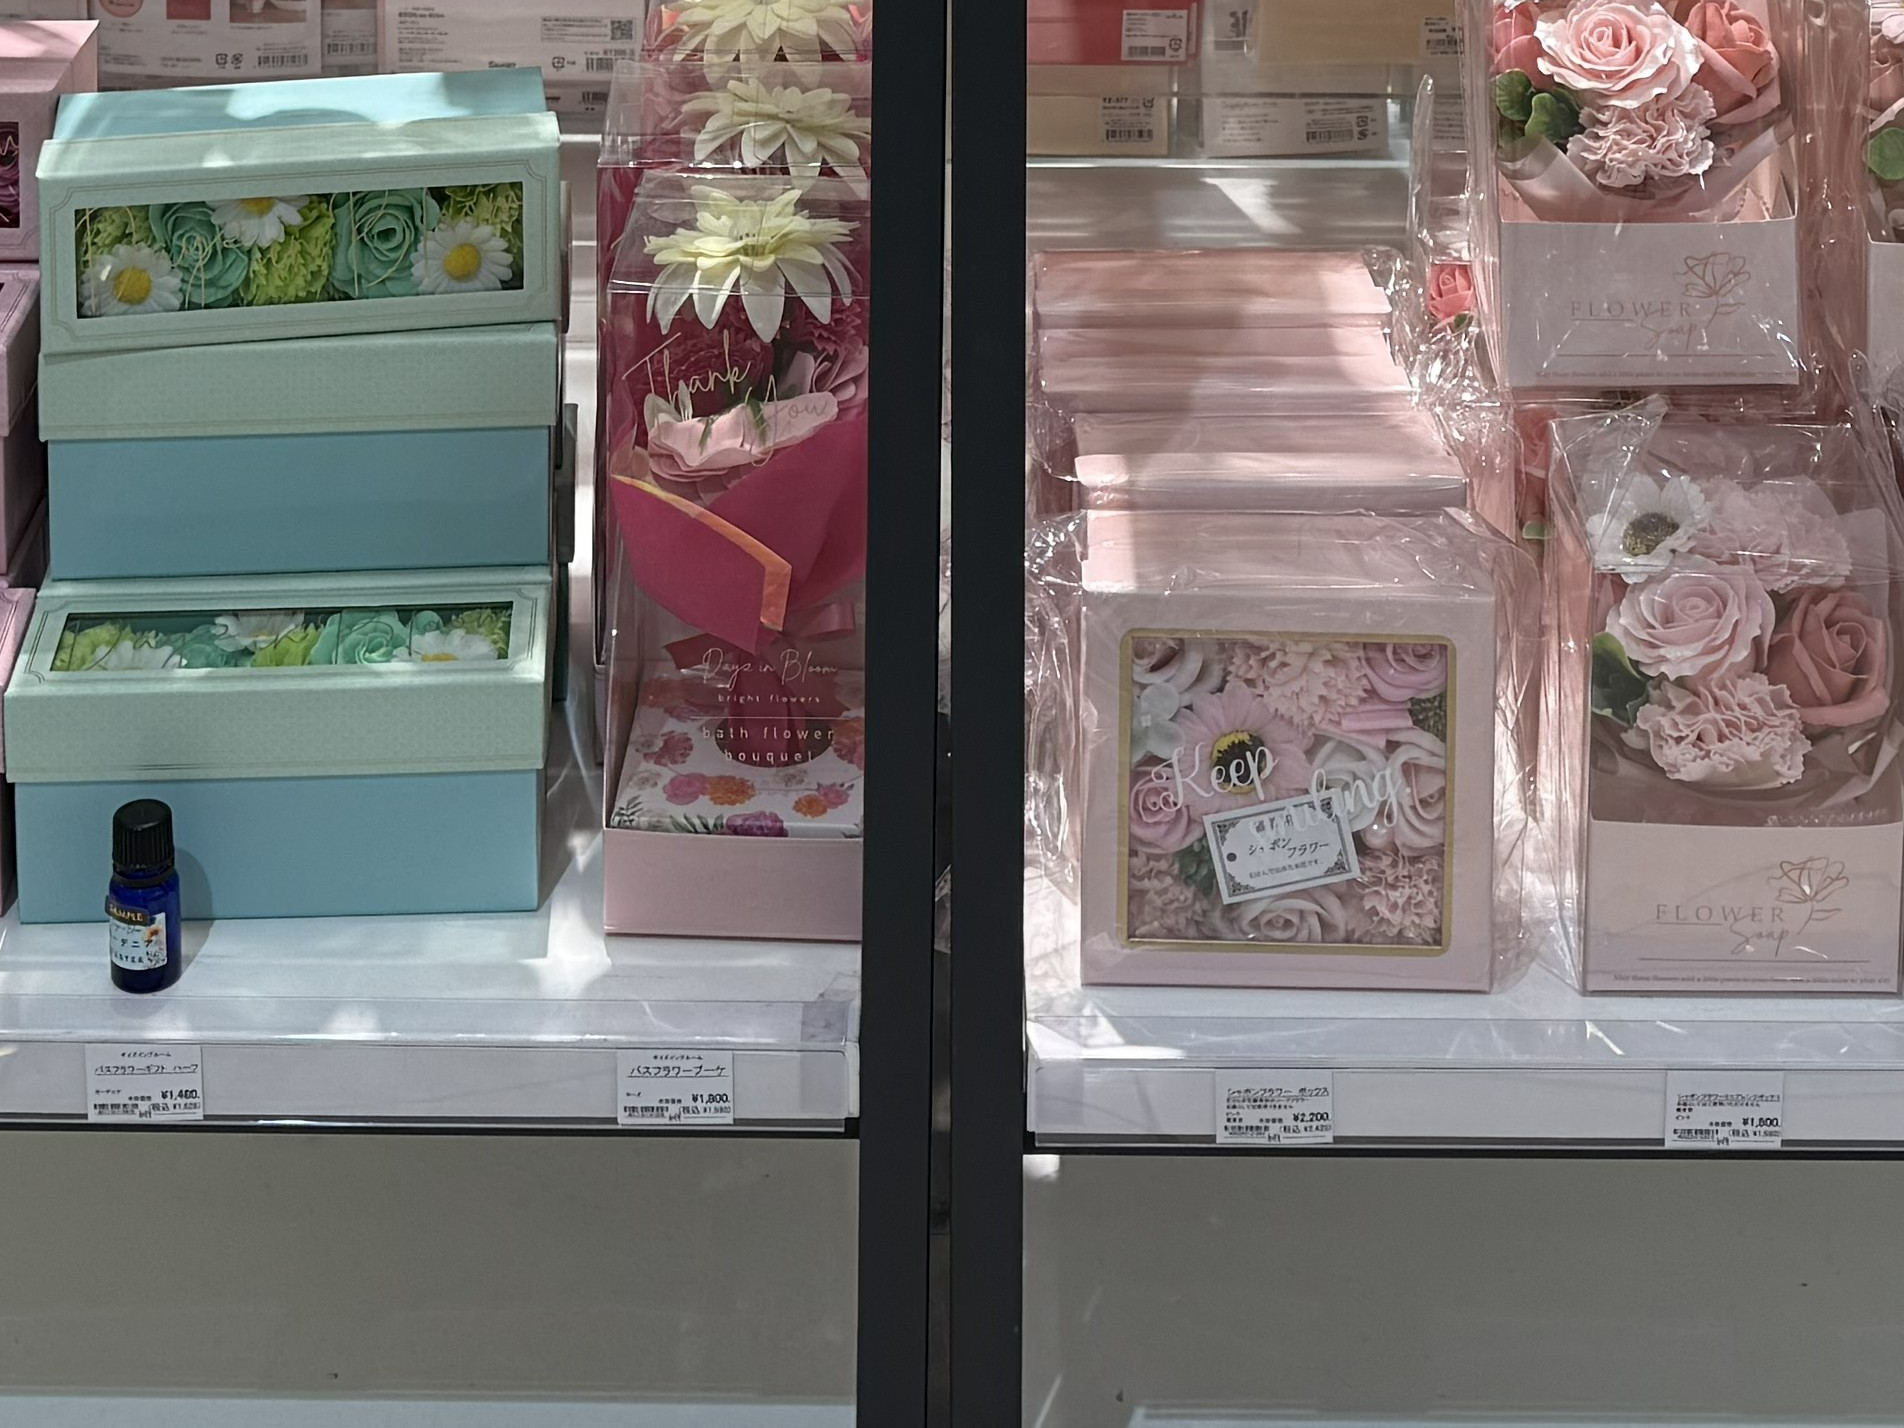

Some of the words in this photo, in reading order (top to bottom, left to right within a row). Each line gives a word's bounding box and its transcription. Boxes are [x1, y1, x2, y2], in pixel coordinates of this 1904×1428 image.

[1570, 300, 1693, 318] FLOWER
[717, 694, 761, 705] bright
[768, 695, 821, 704] flowers
[702, 726, 750, 740] bath
[763, 726, 836, 741] flower
[724, 749, 815, 767] bouquet
[1150, 742, 1279, 813] Keep
[1655, 902, 1785, 924] FLOWER
[630, 1065, 725, 1077] バスフラワーブーケ
